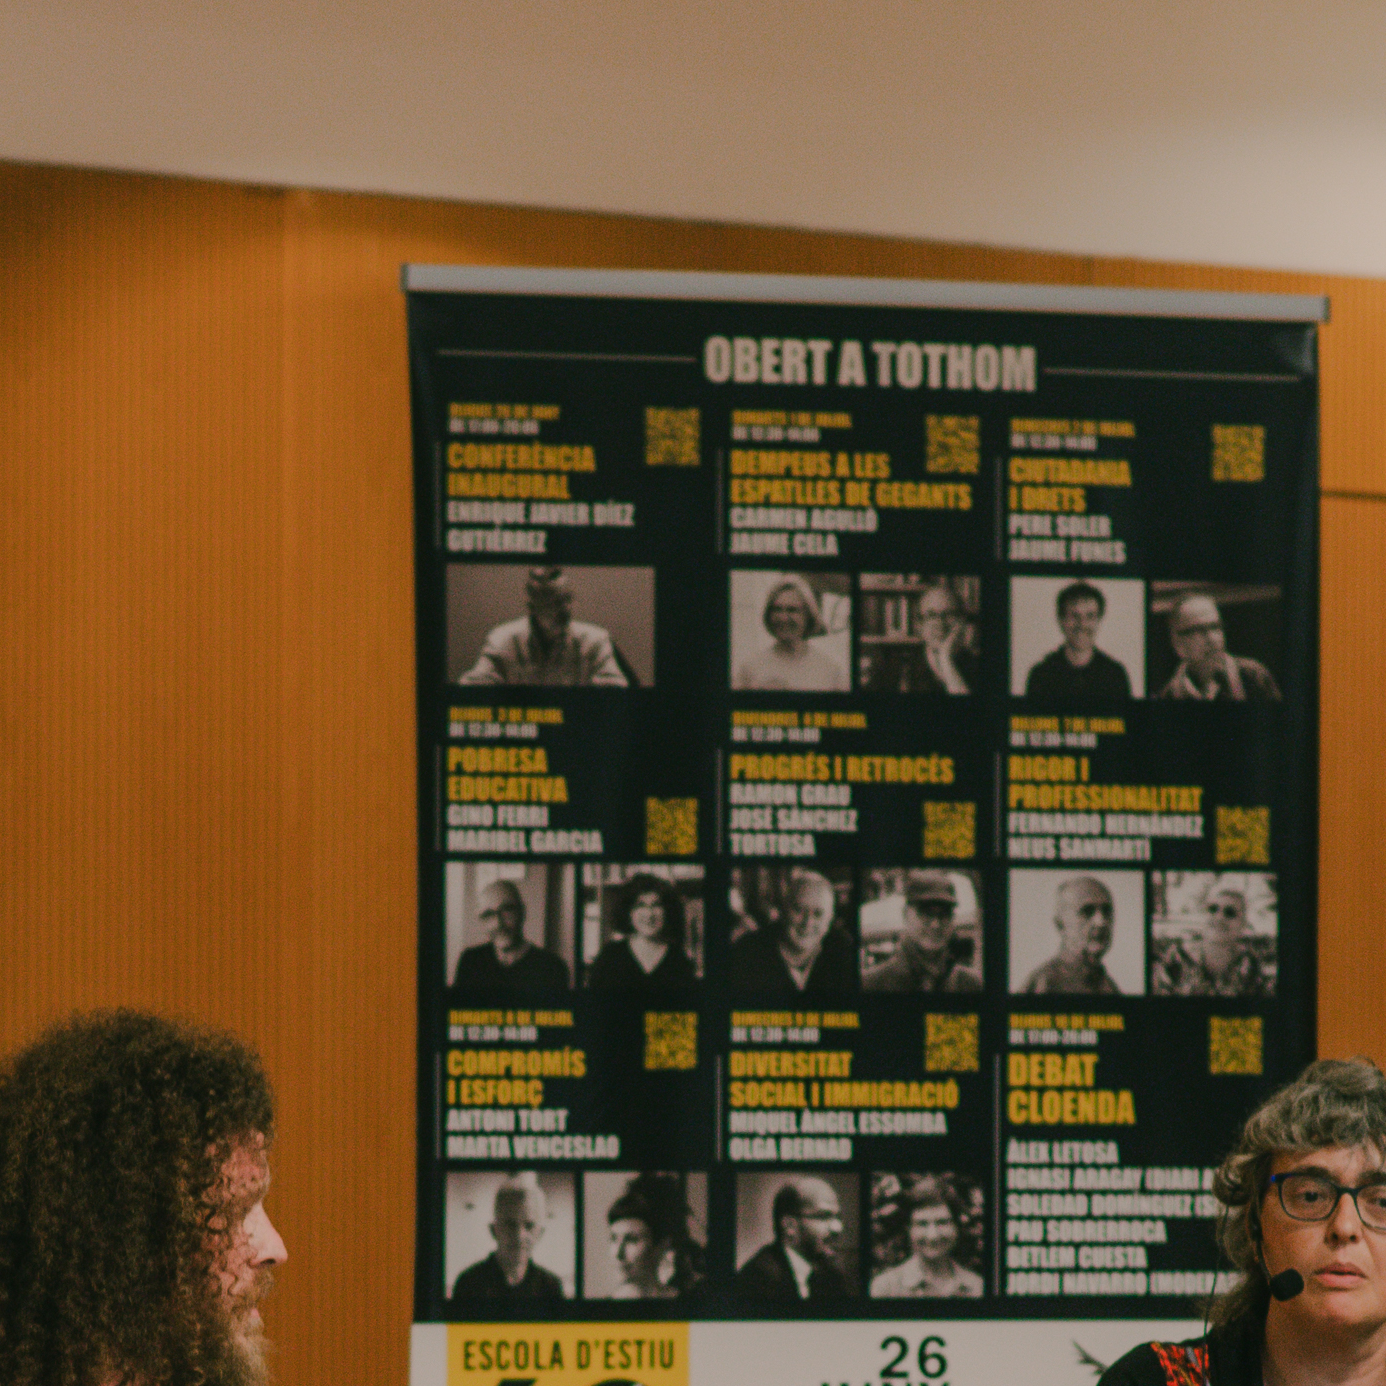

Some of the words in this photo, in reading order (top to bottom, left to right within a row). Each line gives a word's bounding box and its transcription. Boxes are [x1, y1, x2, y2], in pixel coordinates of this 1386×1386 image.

[704, 335, 833, 386] OBERT
[837, 339, 867, 387] A
[871, 340, 1038, 392] TOTHOM
[447, 441, 596, 473] CONFERÈNCIA
[730, 449, 832, 478] DEMPEUS
[835, 451, 851, 478] A
[853, 452, 891, 479] LES
[447, 472, 571, 500] INAUGURAL
[730, 478, 841, 506] ESPATLLES
[845, 480, 871, 507] DE
[875, 481, 974, 511] GEGANTS
[1021, 486, 1087, 513] DRETS
[793, 533, 839, 557] CELA
[447, 747, 549, 774] POBRESA
[730, 752, 830, 781] PROGRÉS
[834, 755, 842, 781] I
[846, 753, 955, 784] RETROCÉS
[1009, 755, 1076, 782] RIGOR
[1080, 756, 1089, 782] I
[447, 775, 569, 803] EDUCATIVA
[729, 782, 798, 806] RAMON
[1009, 784, 1204, 812] PROFESSIONALITAT
[447, 803, 494, 827] GINO
[447, 829, 528, 853] MARIBEL
[730, 833, 816, 857] TORTOSA
[447, 1047, 586, 1078] COMPROMÍS
[730, 1051, 853, 1078] DIVERSITAT
[1008, 1053, 1099, 1087] DEBAT
[447, 1079, 456, 1105] I
[461, 1079, 544, 1108] ESFORÇ
[730, 1081, 808, 1107] SOCIAL
[811, 1082, 820, 1107] I
[824, 1078, 960, 1109] IMMIGRACIÓ
[1008, 1089, 1136, 1125] CLOENDA
[446, 1108, 515, 1132] ANTONI
[518, 1108, 569, 1132] TORT
[729, 1110, 798, 1135] MIQUEL
[859, 1111, 949, 1135] ESSOMBA
[446, 1135, 512, 1159] MARTA
[729, 1137, 778, 1161] OLGA
[1007, 1167, 1071, 1190] IGNASI
[1007, 1194, 1088, 1216] SOLEDAD
[1007, 1219, 1044, 1242] PAU
[1078, 1245, 1148, 1269] CUESTA
[1007, 1271, 1060, 1295] JORDI
[463, 1340, 564, 1371] ESCOLA
[576, 1339, 675, 1370] D'ESTIU
[880, 1335, 948, 1379] 26
